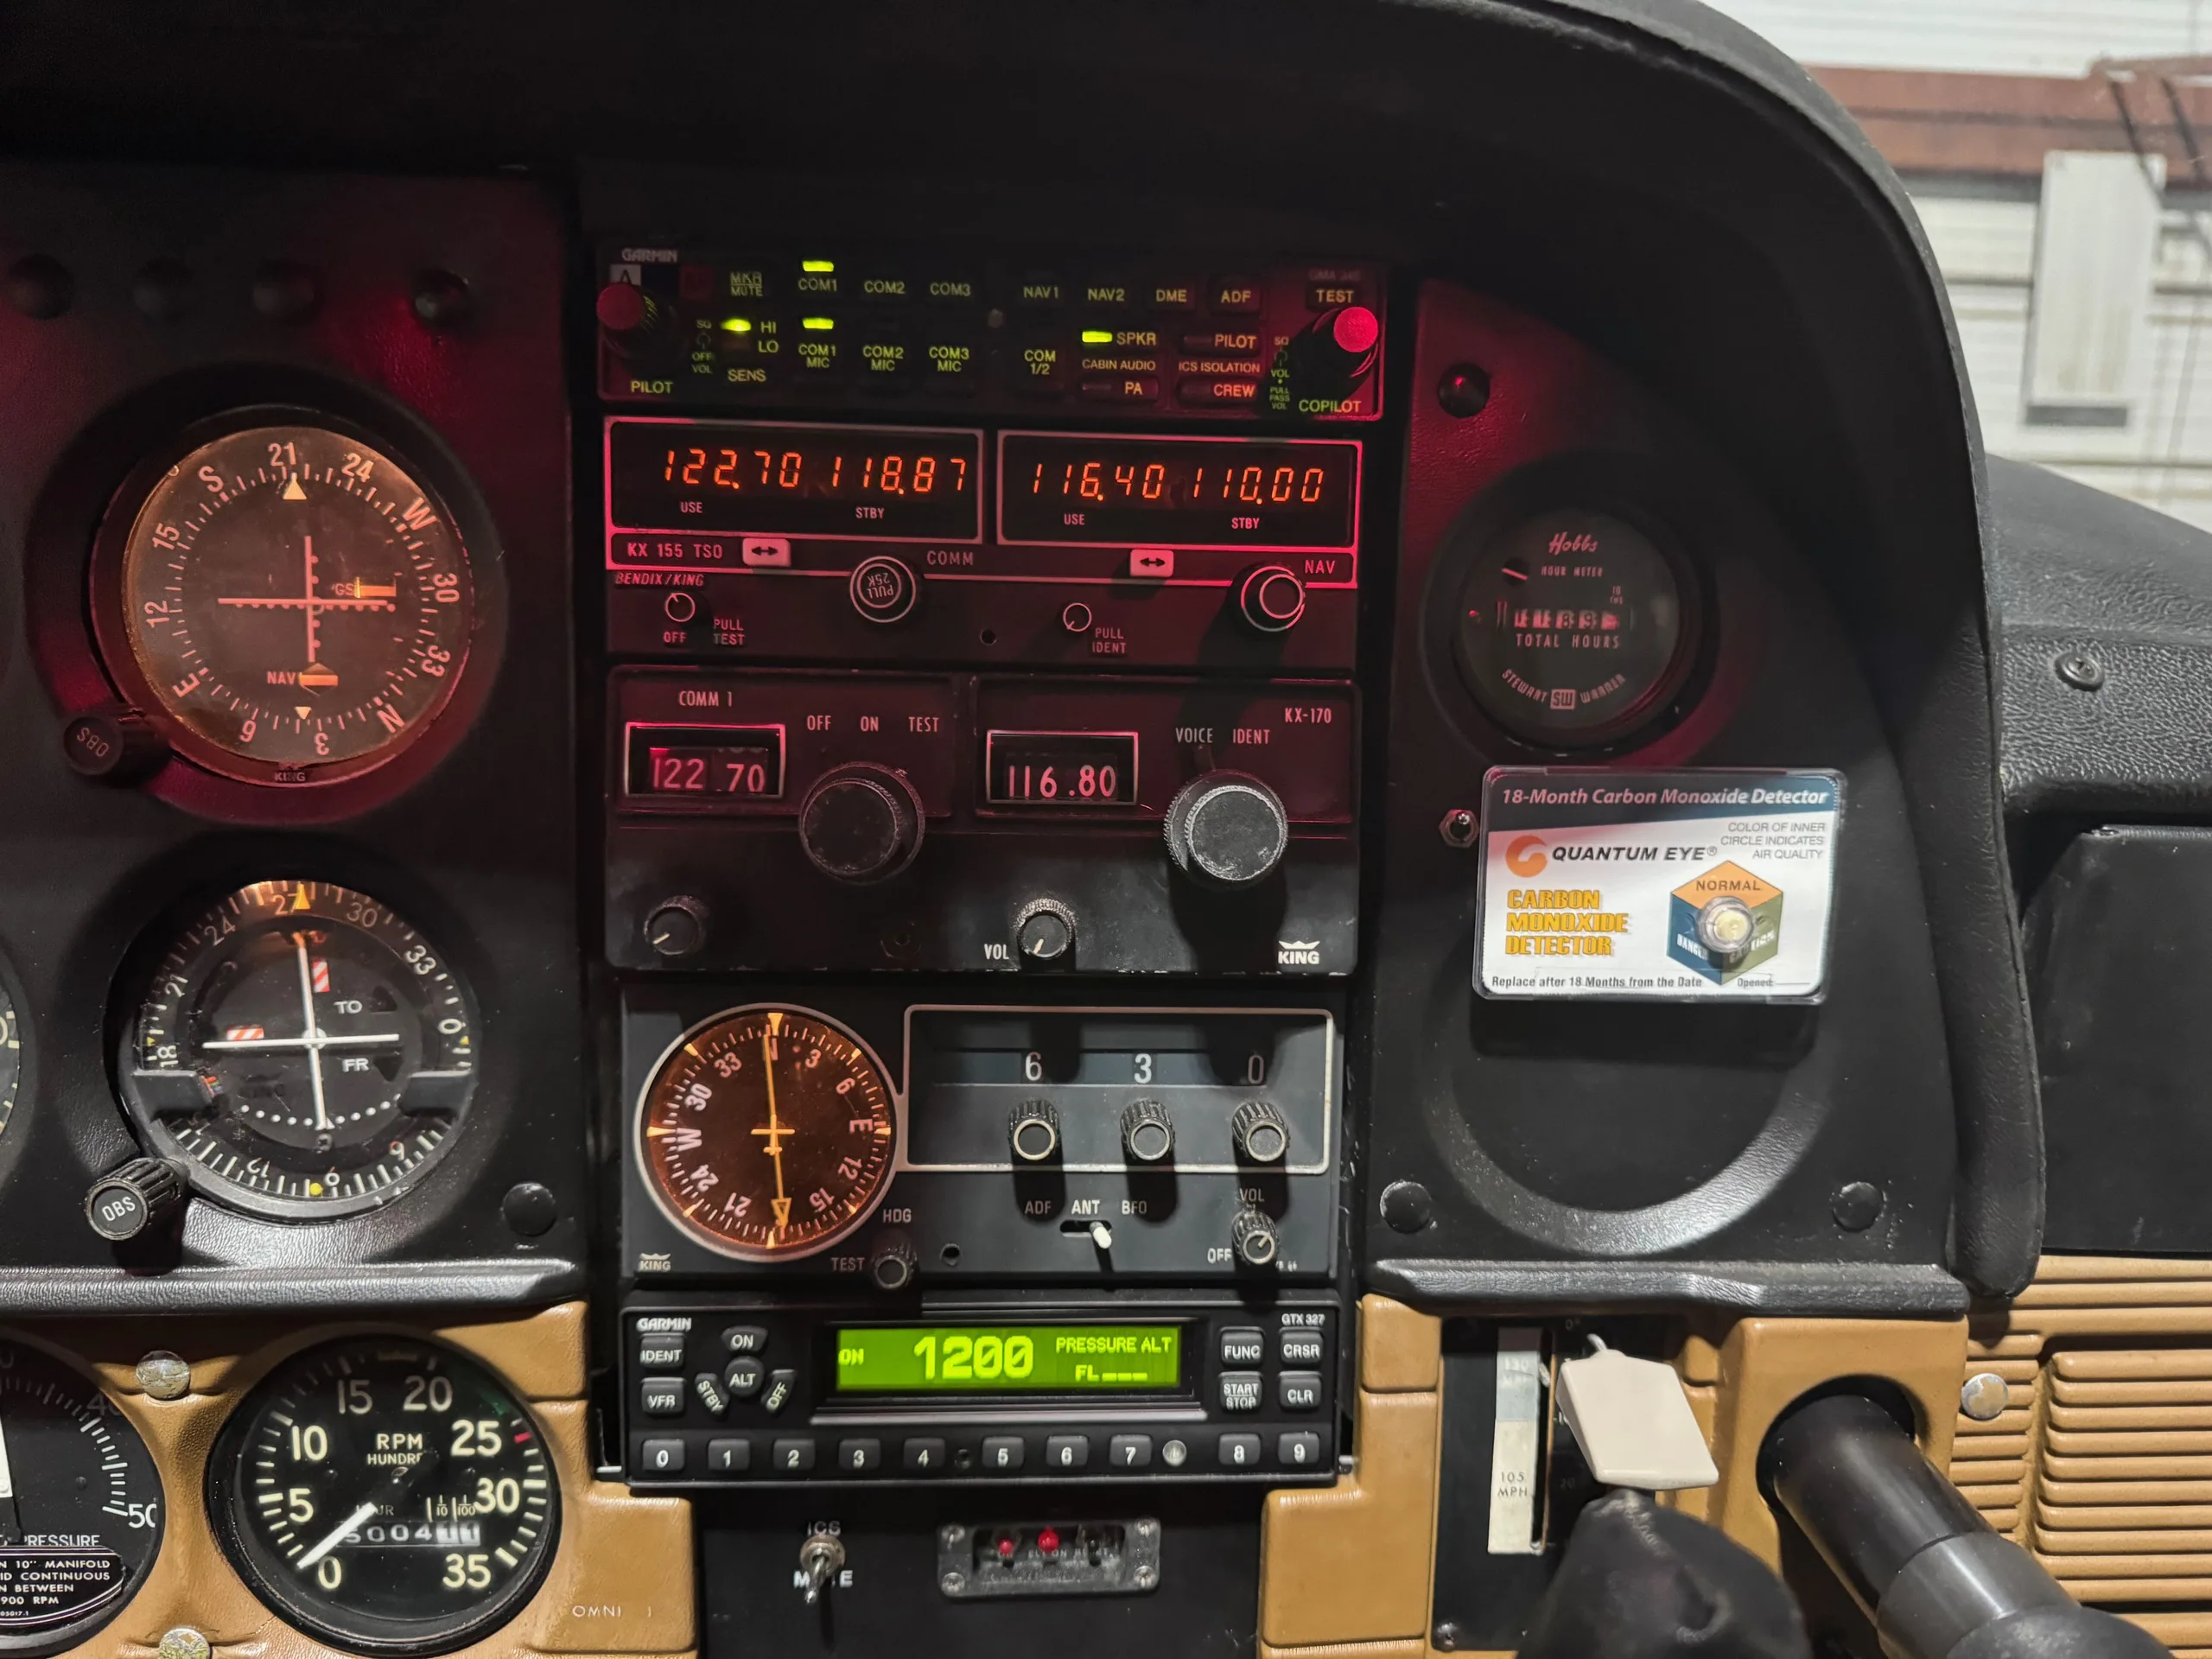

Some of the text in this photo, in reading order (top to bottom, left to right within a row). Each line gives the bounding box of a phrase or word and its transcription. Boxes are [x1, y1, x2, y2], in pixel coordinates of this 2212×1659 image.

[622, 248, 678, 263] GARMIN
[798, 277, 838, 293] COM1
[864, 281, 906, 295] COM2
[930, 283, 971, 296] COM3
[1022, 286, 1060, 299] NAV1
[1087, 289, 1125, 302] NAV2
[1155, 289, 1187, 302] DME
[1220, 289, 1252, 303] ADF
[1315, 289, 1355, 303] TEST
[760, 321, 777, 334] HI
[758, 340, 779, 353] LO
[1116, 332, 1157, 346] SPKR
[1214, 334, 1257, 349] PILOT
[798, 344, 837, 357] COM1
[863, 346, 905, 359] COM2
[929, 346, 970, 360] COM3
[1023, 349, 1057, 363] COM
[805, 357, 830, 369] MIC
[871, 359, 896, 372] MIC
[938, 359, 962, 372] MIC
[1031, 363, 1051, 376] 1/2
[1082, 359, 1156, 372] CABIN AUDIO
[1179, 360, 1261, 374] ICS ISOLATION
[727, 368, 766, 383] SENS
[1270, 368, 1290, 378] VOL
[630, 380, 674, 394] PILOT
[1124, 381, 1144, 396] PA
[1213, 384, 1255, 397] CREW
[1298, 399, 1362, 414] COPILOT
[268, 442, 297, 467] 21
[341, 452, 375, 483] 24
[664, 448, 967, 495] 122.70 118.87
[1033, 463, 1325, 505] 116.40 110.00
[680, 501, 703, 514] USE
[855, 506, 885, 519] STBY
[1063, 513, 1085, 525] USE
[1230, 517, 1261, 530] STBY
[151, 522, 181, 552] 15
[1548, 531, 1599, 555] Hobbs
[627, 543, 723, 559] KX 155 TSO
[926, 550, 975, 566] COMM
[1304, 560, 1336, 575] NAV
[614, 572, 705, 588] BENDIX/KING
[433, 572, 461, 604] 30
[867, 585, 894, 600] PULL
[144, 600, 170, 629] 12
[713, 619, 744, 632] PULL
[663, 632, 688, 644] OFF
[713, 632, 746, 645] TEST
[1095, 627, 1125, 640] PULL
[1516, 632, 1620, 649] TOTAL HOURS
[1092, 640, 1127, 654] IDENT
[422, 645, 451, 678] 33
[267, 671, 296, 685] NAV
[678, 691, 719, 707] COMM
[806, 715, 832, 731] OFF
[1284, 708, 1332, 723] KX-170
[860, 716, 880, 732] ON
[908, 716, 939, 733] TEST
[1175, 728, 1213, 744] VOICE
[1232, 728, 1271, 745] IDENT
[1502, 787, 1829, 805] 18-Month Carbon Monoxide Detector
[1728, 822, 1826, 833] COLOR OF INNER
[1719, 835, 1825, 847] CIRCLE INDICATES
[1552, 846, 1658, 862] QUANTUM
[1752, 849, 1823, 861] AIR QUALITY
[1695, 880, 1762, 892] NORMAL
[1506, 889, 1601, 910] CARBON
[346, 902, 378, 929] 30
[1505, 912, 1630, 934] MONOXIDE
[204, 919, 236, 947] 24
[983, 944, 1009, 960] VOL
[1504, 935, 1613, 957] DETECTOR
[404, 945, 437, 976] 33
[1278, 950, 1320, 965] KING
[1491, 976, 1702, 988] Replace after 18 Months from the Date
[334, 1000, 364, 1014] TO
[342, 1058, 370, 1073] FR
[714, 1052, 743, 1078] 33
[684, 1082, 714, 1112] 30
[1240, 1188, 1265, 1203] VOL
[100, 1196, 137, 1223] OBS
[1024, 1199, 1052, 1215] ADF
[1071, 1199, 1100, 1215] ANT
[1122, 1199, 1147, 1215] BFO
[882, 1208, 912, 1223] HDG
[1207, 1248, 1233, 1263] OFF
[639, 1260, 671, 1271] KING
[831, 1256, 865, 1271] TEST
[636, 1318, 692, 1332] GARMIN
[1281, 1313, 1325, 1326] GTX 327
[731, 1334, 754, 1349] ON
[1056, 1337, 1173, 1354] PRESSURE ALT
[640, 1349, 682, 1363] IDENT
[838, 1349, 864, 1366] ON
[1224, 1344, 1262, 1359] FUNC
[1283, 1344, 1320, 1358] CRSR
[913, 1336, 1034, 1382] 1200
[729, 1373, 757, 1387] ALT
[338, 1378, 372, 1414] 15
[403, 1375, 454, 1413] 20
[1224, 1382, 1259, 1396] START
[1287, 1389, 1313, 1404] CLR
[648, 1395, 676, 1409] VFR
[1225, 1395, 1257, 1410] STOP
[291, 1424, 328, 1461] 10
[376, 1433, 423, 1450] RPM
[450, 1419, 502, 1458] 25
[655, 1449, 669, 1467] 0
[721, 1449, 733, 1467] 1
[787, 1449, 800, 1467] 2
[853, 1449, 865, 1467] 3
[917, 1449, 930, 1466] 4
[997, 1447, 1008, 1466] 5
[1060, 1446, 1073, 1465] 6
[1124, 1446, 1137, 1465] 7
[1233, 1445, 1245, 1464] 8
[1294, 1443, 1306, 1462] 9
[1501, 1471, 1525, 1483] 105
[474, 1477, 520, 1514] 30
[1497, 1487, 1528, 1498] MPH
[288, 1487, 315, 1523] 5
[44, 1560, 111, 1570] MANIFOLD
[442, 1553, 492, 1590] 35
[20, 1571, 111, 1581] CONTINUOUS
[14, 1583, 74, 1593] BETWEEN
[33, 1595, 60, 1605] RPM
[572, 1605, 621, 1618] OMNI
